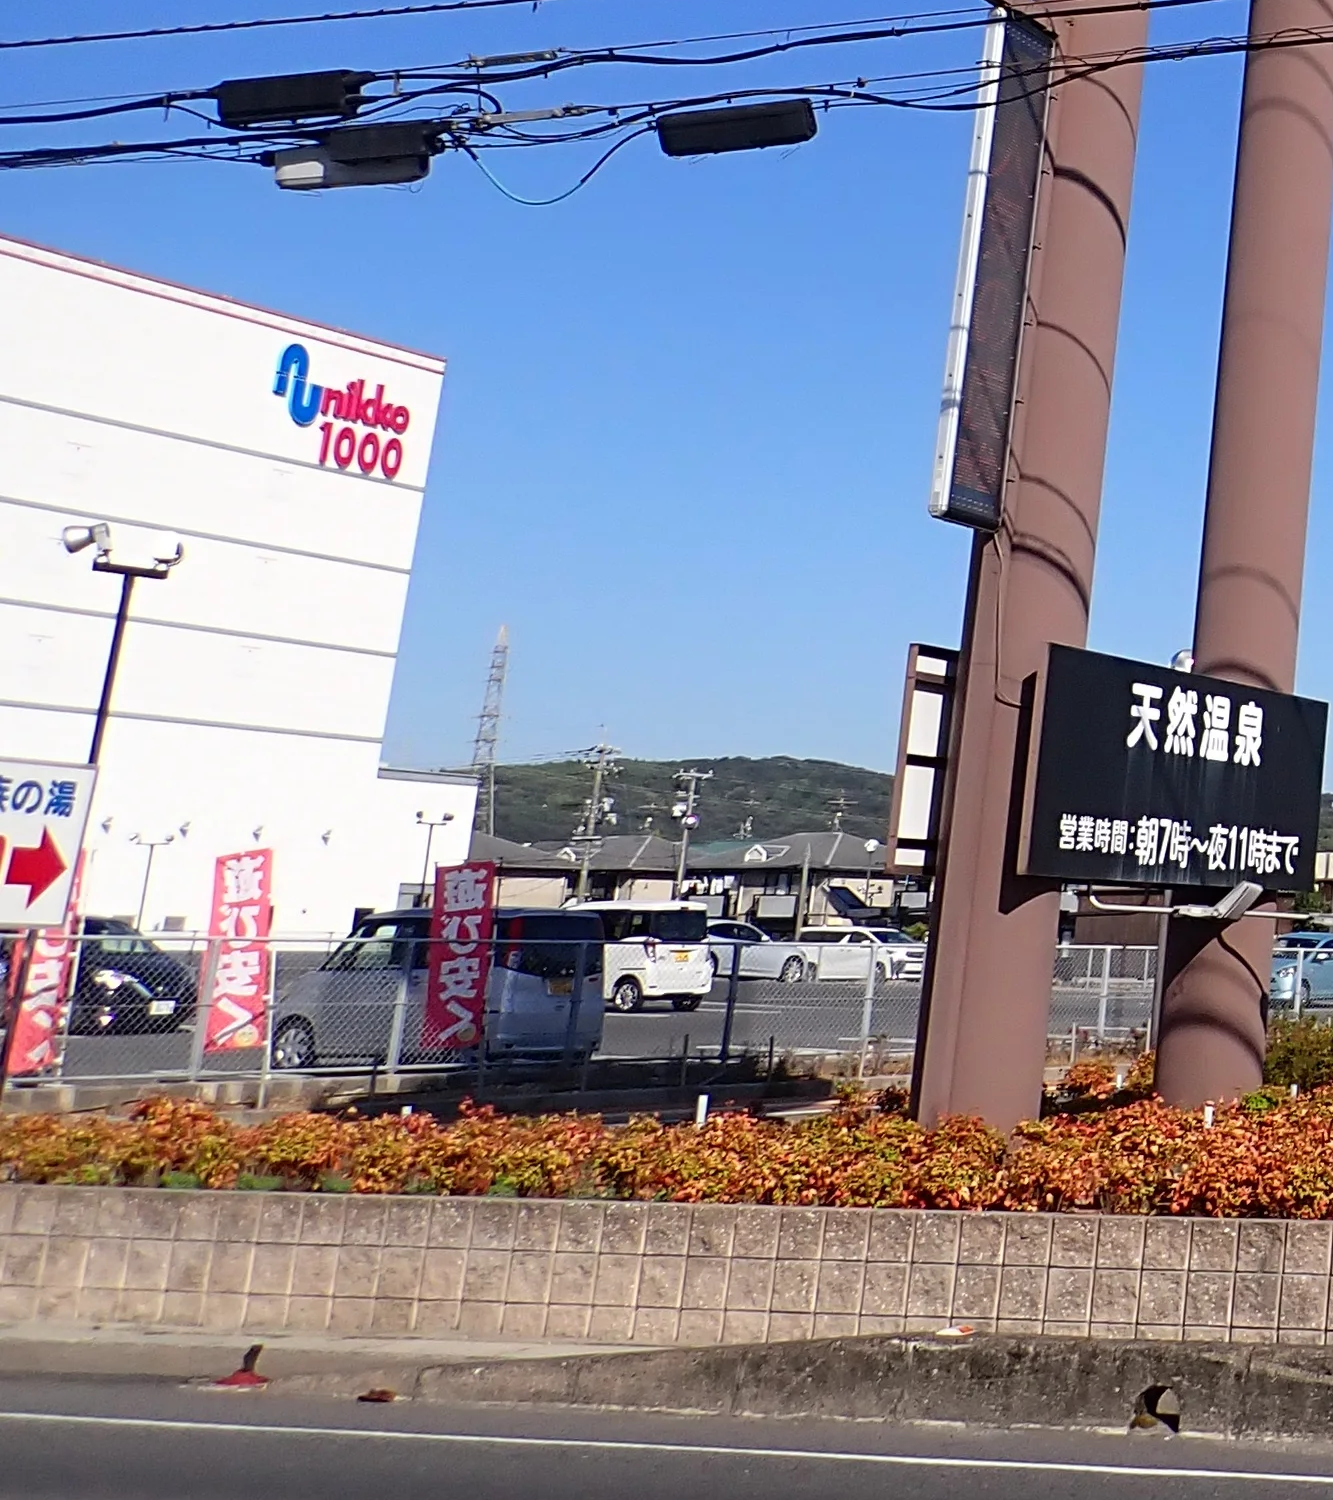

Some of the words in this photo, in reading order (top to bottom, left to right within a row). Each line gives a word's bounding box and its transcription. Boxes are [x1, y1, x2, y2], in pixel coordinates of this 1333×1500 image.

[321, 379, 410, 435] nikko
[319, 422, 403, 481] 1000
[1126, 682, 1264, 767] 天然温泉
